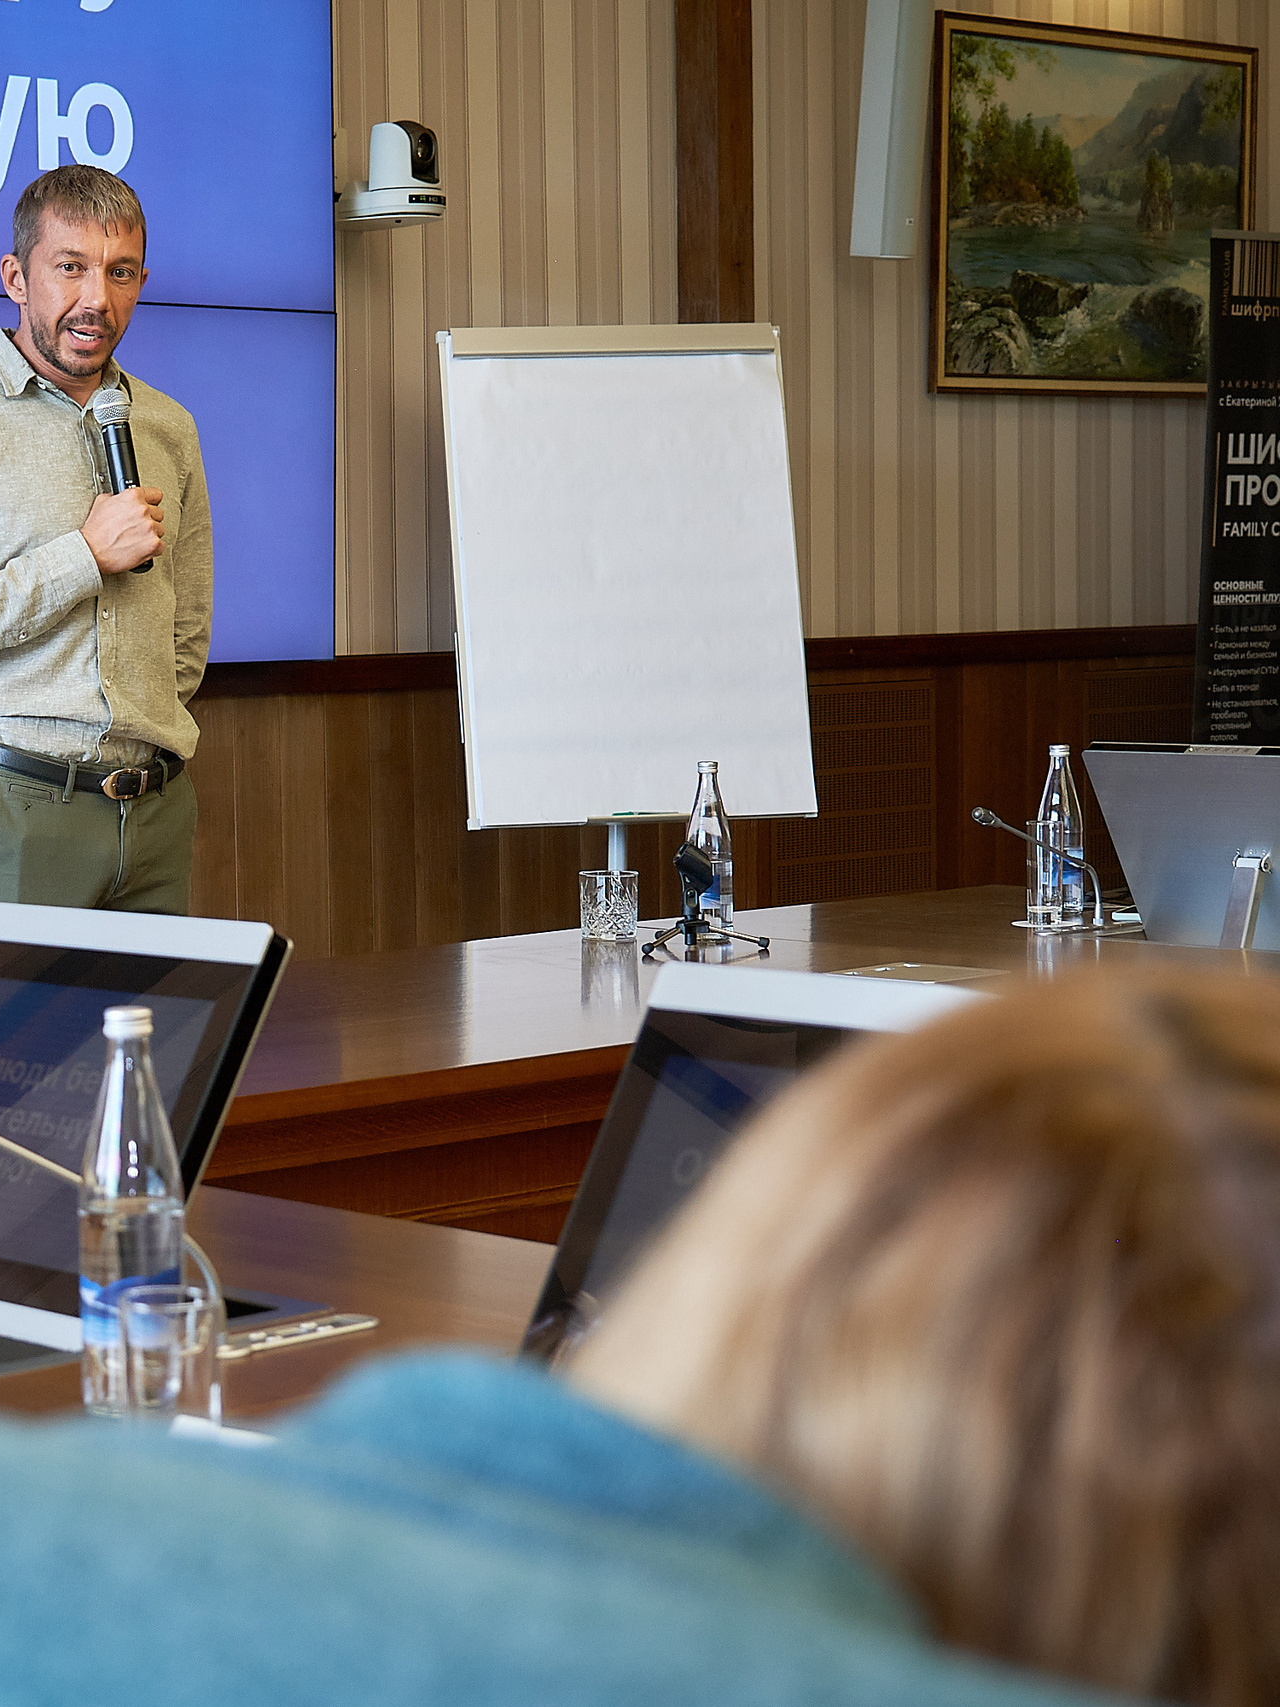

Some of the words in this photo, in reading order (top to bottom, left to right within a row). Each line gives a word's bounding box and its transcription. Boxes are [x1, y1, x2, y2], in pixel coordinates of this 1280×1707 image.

[1218, 397, 1224, 407] с
[1225, 394, 1277, 410] Екатериной
[1226, 432, 1280, 466] ШИ
[1224, 473, 1280, 507] ПРО
[1222, 521, 1269, 538] FAMILY
[1213, 580, 1264, 591] ОСНОВНЫЕ
[1212, 593, 1261, 604] ЦЕННОСТИ
[1262, 593, 1280, 603] КЛУ
